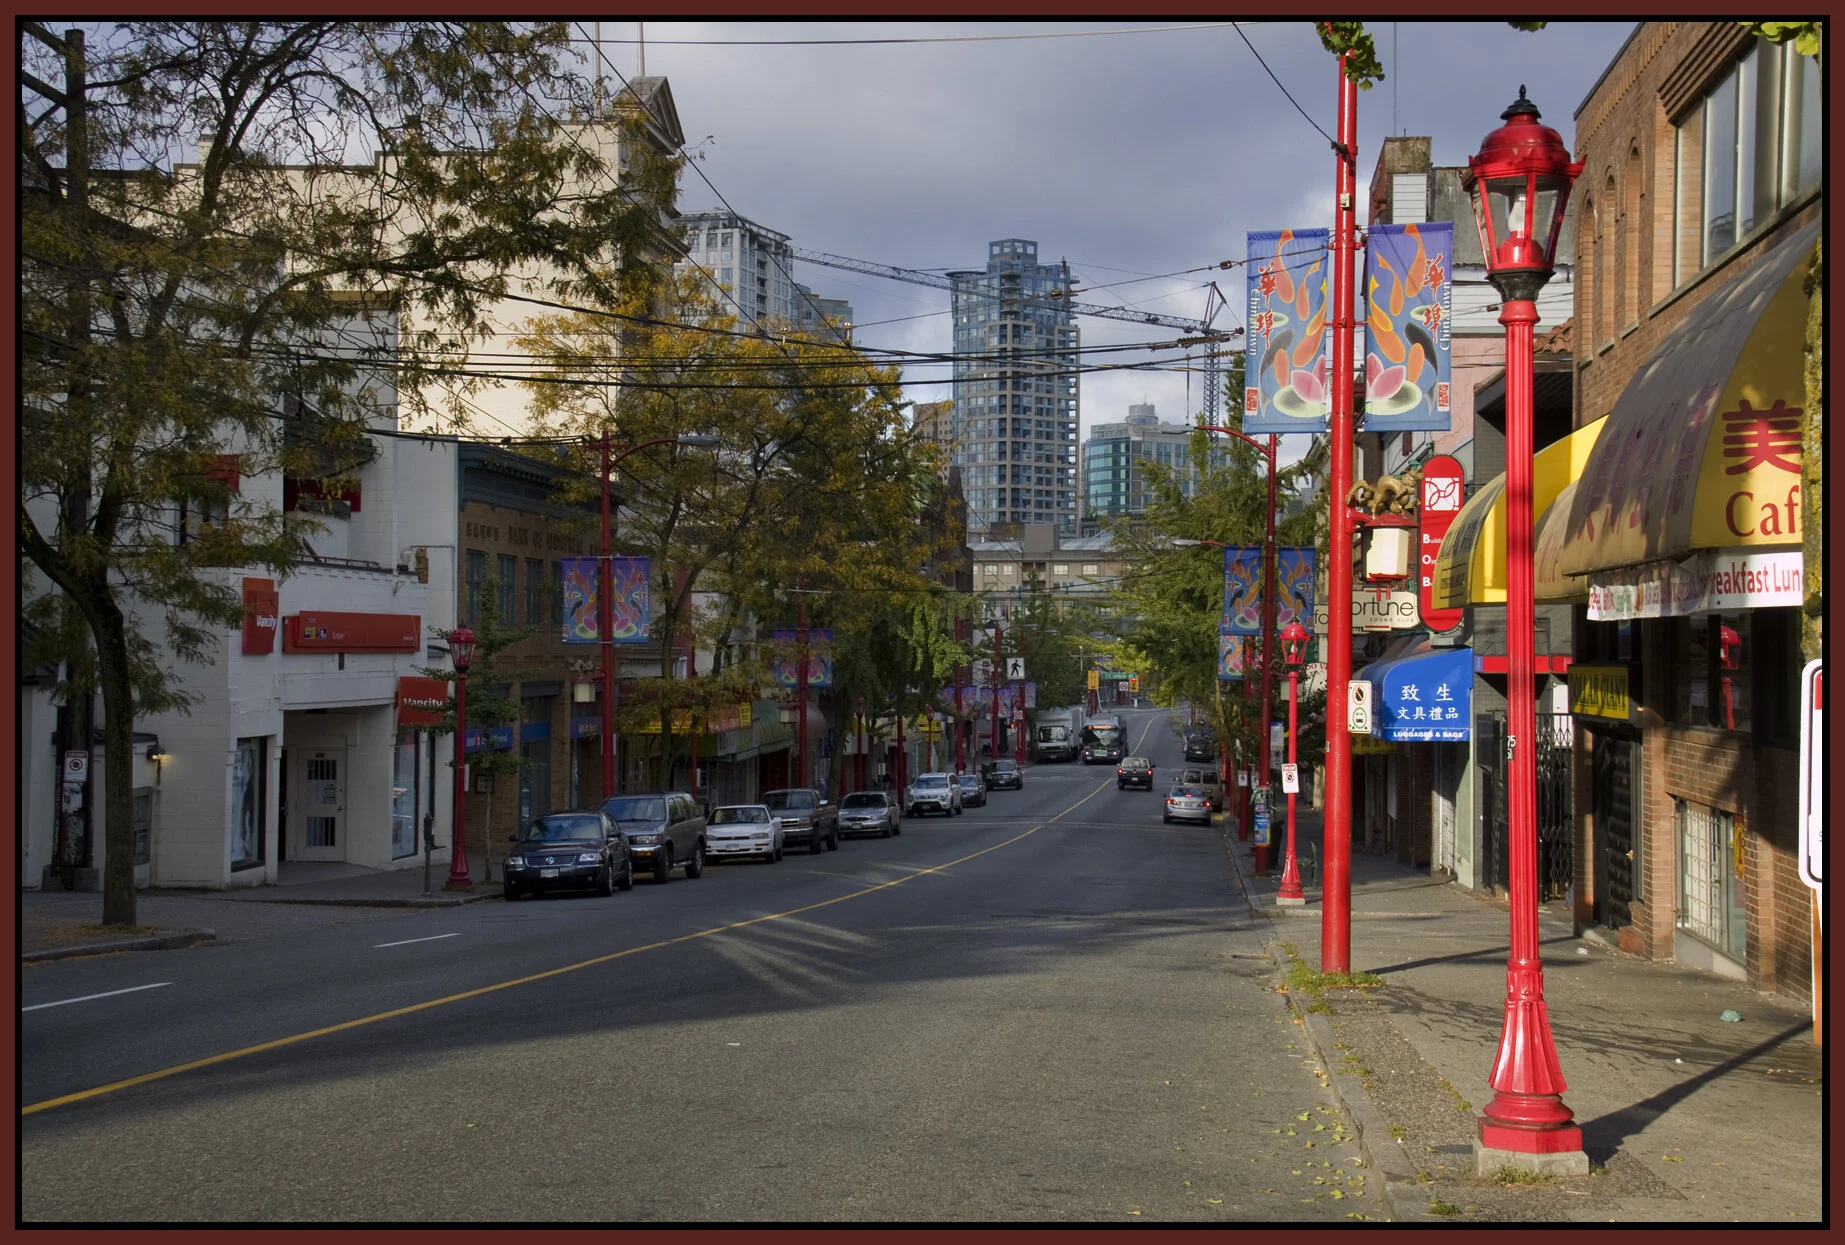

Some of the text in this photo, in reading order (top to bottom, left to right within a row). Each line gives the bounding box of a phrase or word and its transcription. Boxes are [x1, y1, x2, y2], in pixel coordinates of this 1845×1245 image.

[1422, 252, 1446, 344] 華埠
[1721, 398, 1804, 476] 美
[1724, 484, 1802, 538] Caf
[1772, 560, 1803, 594] Lun
[256, 613, 277, 631] Vancity
[1352, 597, 1414, 617] ortune
[1396, 706, 1460, 721] 文具禮品
